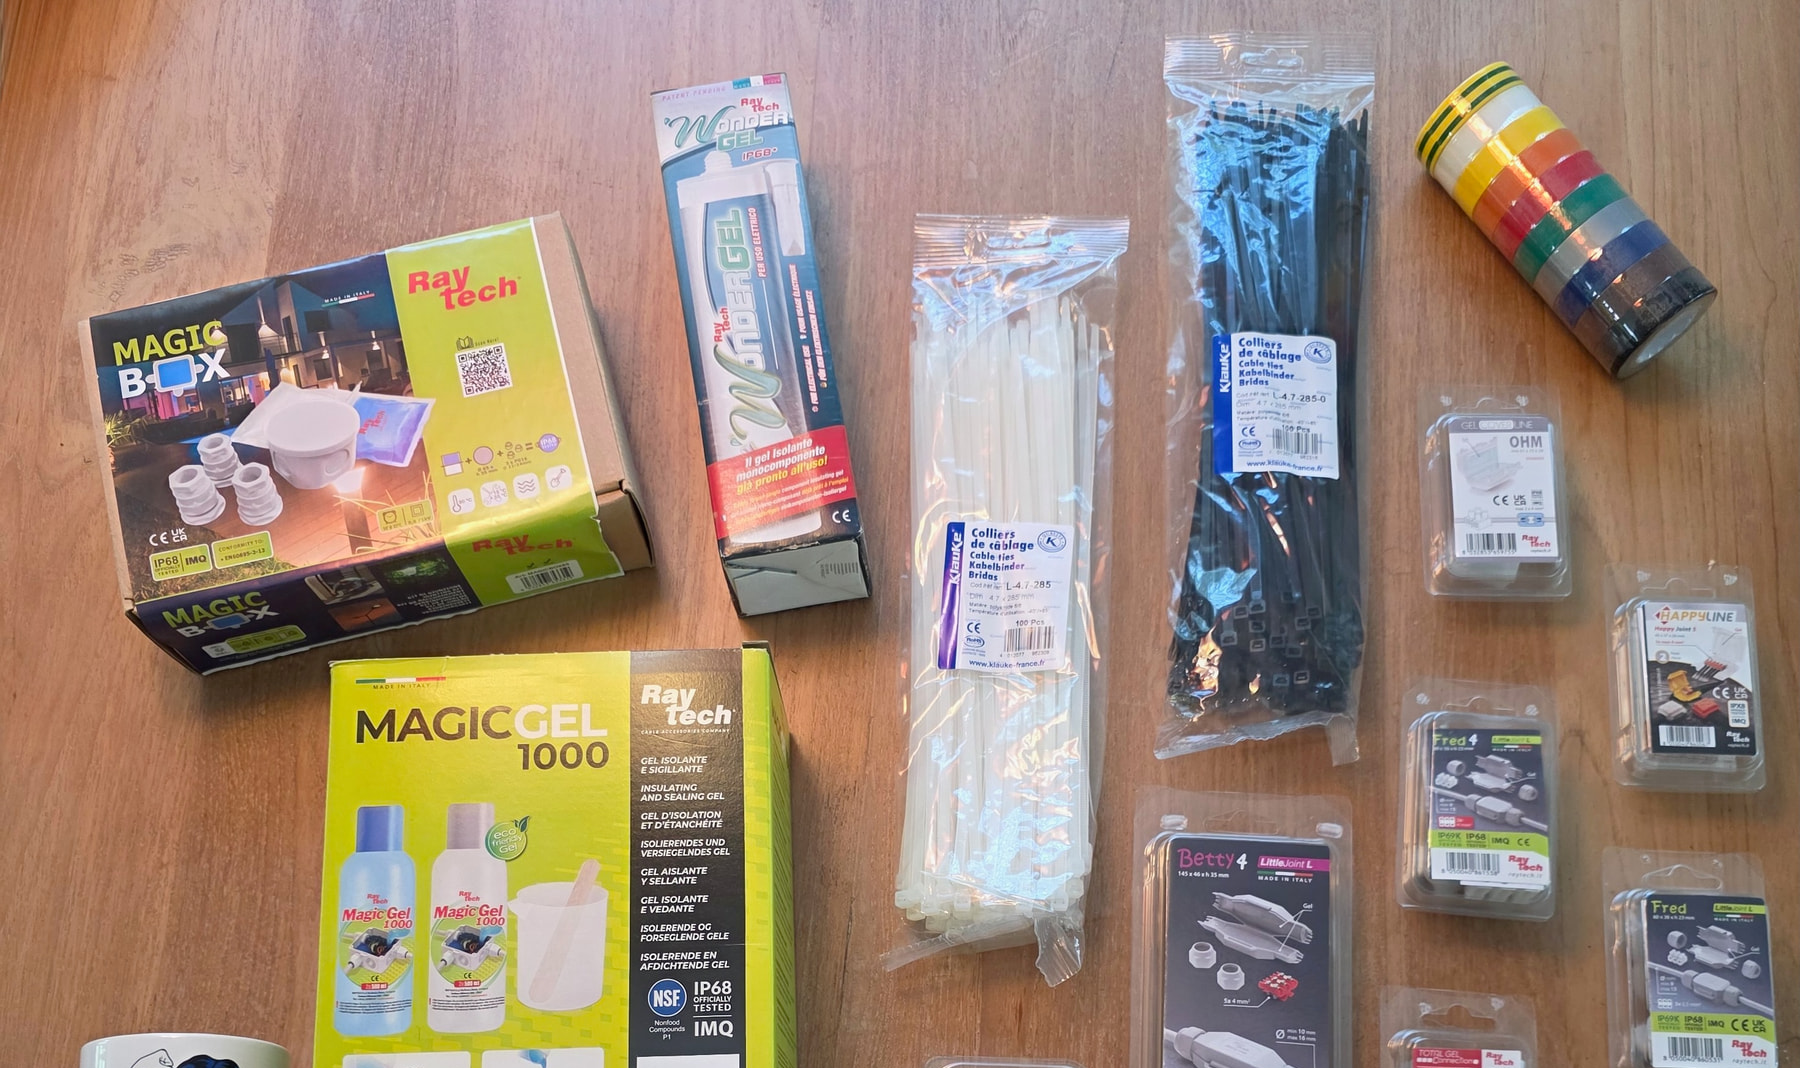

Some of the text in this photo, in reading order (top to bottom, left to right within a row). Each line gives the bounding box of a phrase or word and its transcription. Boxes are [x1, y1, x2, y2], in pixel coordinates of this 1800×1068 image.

[717, 130, 763, 151] GEL
[714, 209, 750, 271] GEL
[748, 207, 767, 278] PER USO ELETTRICO
[409, 266, 470, 294] Ray
[113, 320, 227, 366] MAGIC
[1239, 338, 1282, 350] Colliers
[1239, 348, 1301, 363] de câblage
[1239, 360, 1283, 370] Cable ties
[1239, 370, 1294, 380] Kabelbinder
[1510, 436, 1542, 448] OHM
[736, 446, 825, 482] monocomponente
[971, 528, 1015, 539] Colliers
[971, 539, 1034, 552] de câblage
[154, 555, 207, 568] IP68 IMQ
[970, 551, 1015, 561] Cable ties
[969, 561, 1024, 571] Kabelbinder
[969, 571, 998, 581] Bridas
[162, 591, 267, 628] MAGIC
[1660, 609, 1734, 623] HAPPYLINE
[969, 658, 1046, 669] www.klauke-france.fr
[640, 684, 697, 711] Ray
[1433, 734, 1478, 746] Fred 4
[517, 741, 609, 770] 1000
[640, 756, 708, 765] GEL ISOLANTE
[641, 765, 703, 774] E SIGILLANTE
[640, 784, 697, 792] INSULATING
[640, 792, 725, 801] AND SEALING GEL
[640, 811, 722, 820] GEL D'ISOLATION
[655, 818, 723, 829] D'ÉTANCHÉITÉ
[640, 840, 704, 848] ISOLIERENDES
[640, 847, 731, 857] VERSIEGELNDES GEL
[1177, 849, 1248, 870] Betty 4
[434, 905, 503, 919] Magic Gel
[1652, 901, 1687, 913] Fred
[342, 908, 411, 922] Magic Gel
[383, 919, 413, 929] 1000
[476, 917, 505, 926] 1000
[694, 981, 732, 995] IP68
[653, 989, 681, 1007] NSF
[693, 1003, 732, 1012] TESTED
[694, 1020, 734, 1038] IMQ
